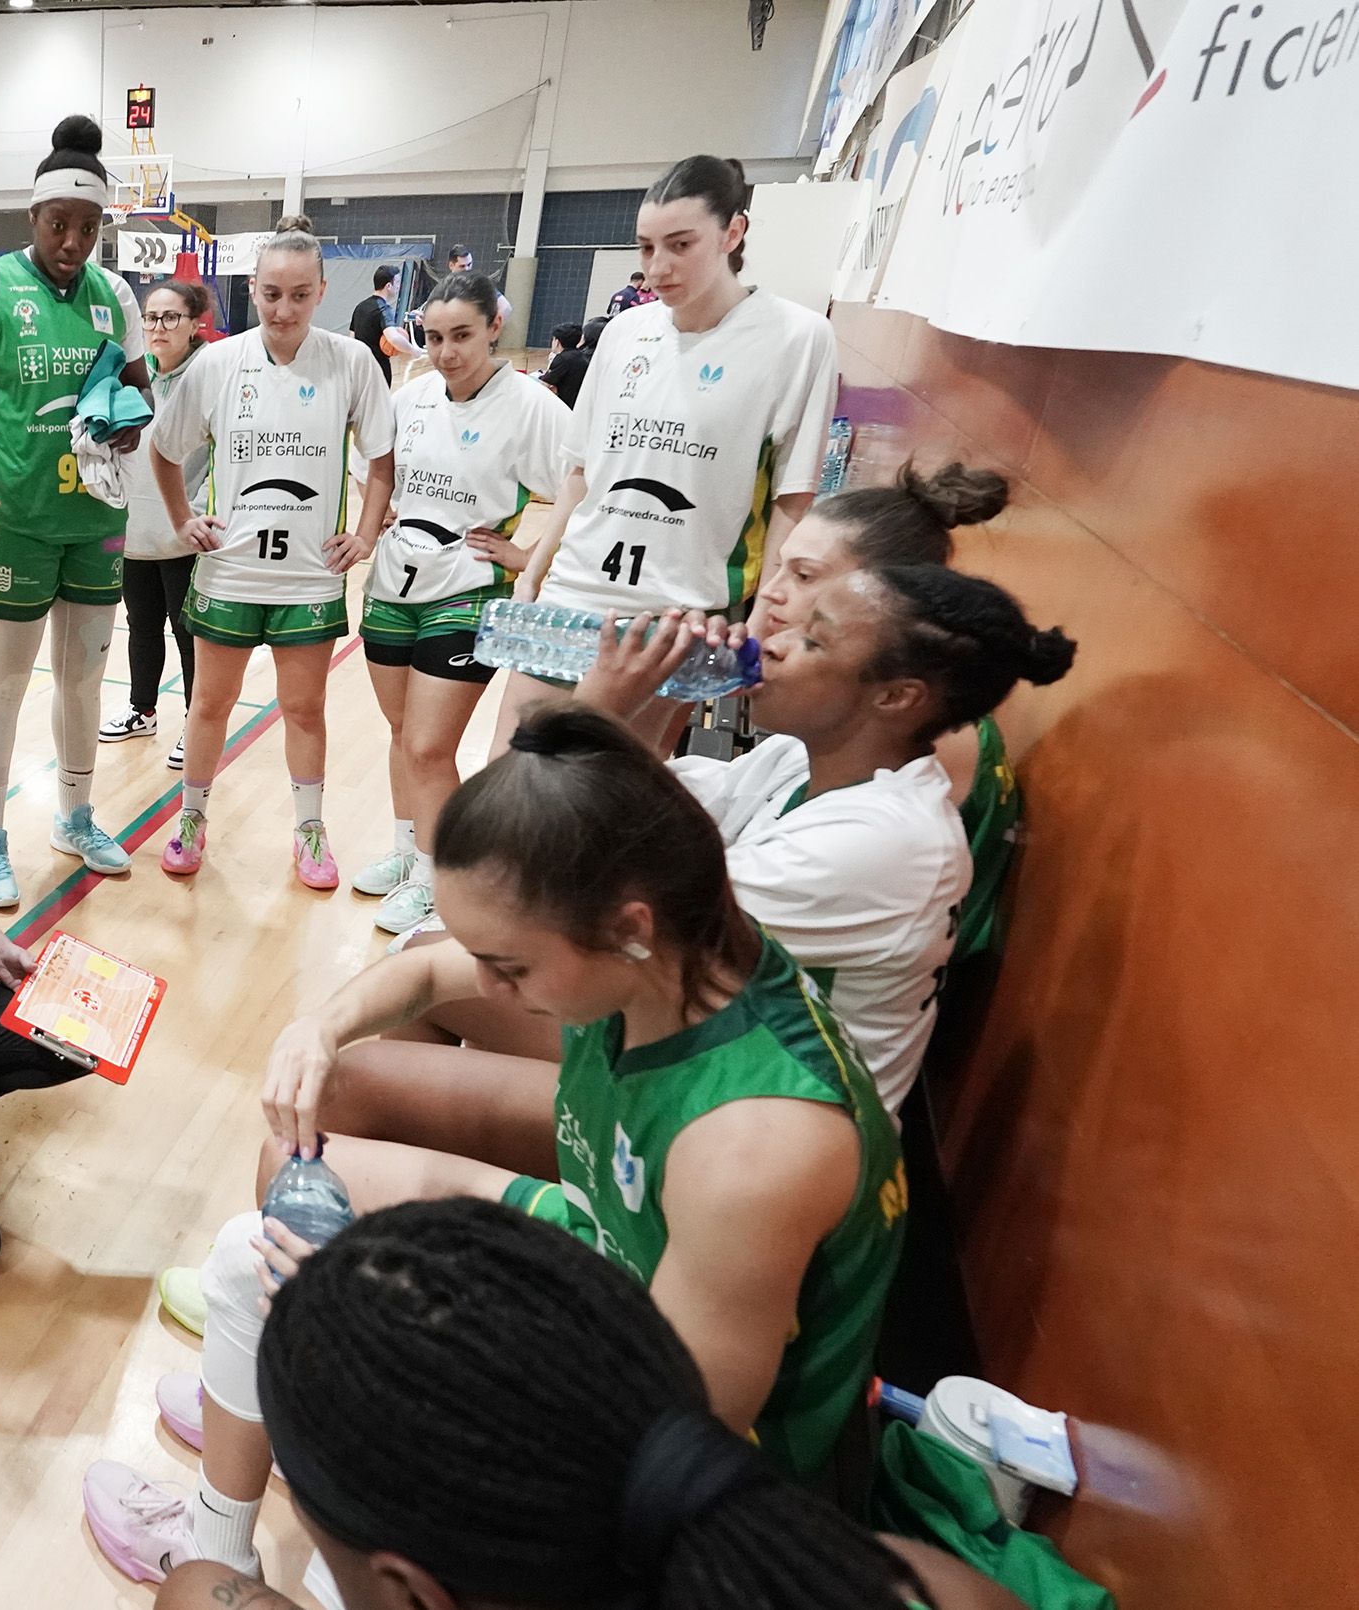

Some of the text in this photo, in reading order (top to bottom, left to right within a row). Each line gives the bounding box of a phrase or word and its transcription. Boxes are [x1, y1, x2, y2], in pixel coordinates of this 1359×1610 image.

[129, 105, 150, 126] 24
[53, 362, 71, 375] DE
[631, 417, 685, 437] XUNTA
[257, 432, 302, 444] XUNTA
[628, 434, 718, 461] DE GALICIA
[257, 444, 327, 457] DE GALICIA
[57, 453, 88, 494] 9
[409, 468, 453, 486] XUNTA
[407, 482, 477, 506] DE GALICIA
[232, 502, 313, 512] visit-pontevedra.com
[257, 529, 289, 561] 15
[601, 541, 646, 586] 41
[398, 564, 418, 599] 7
